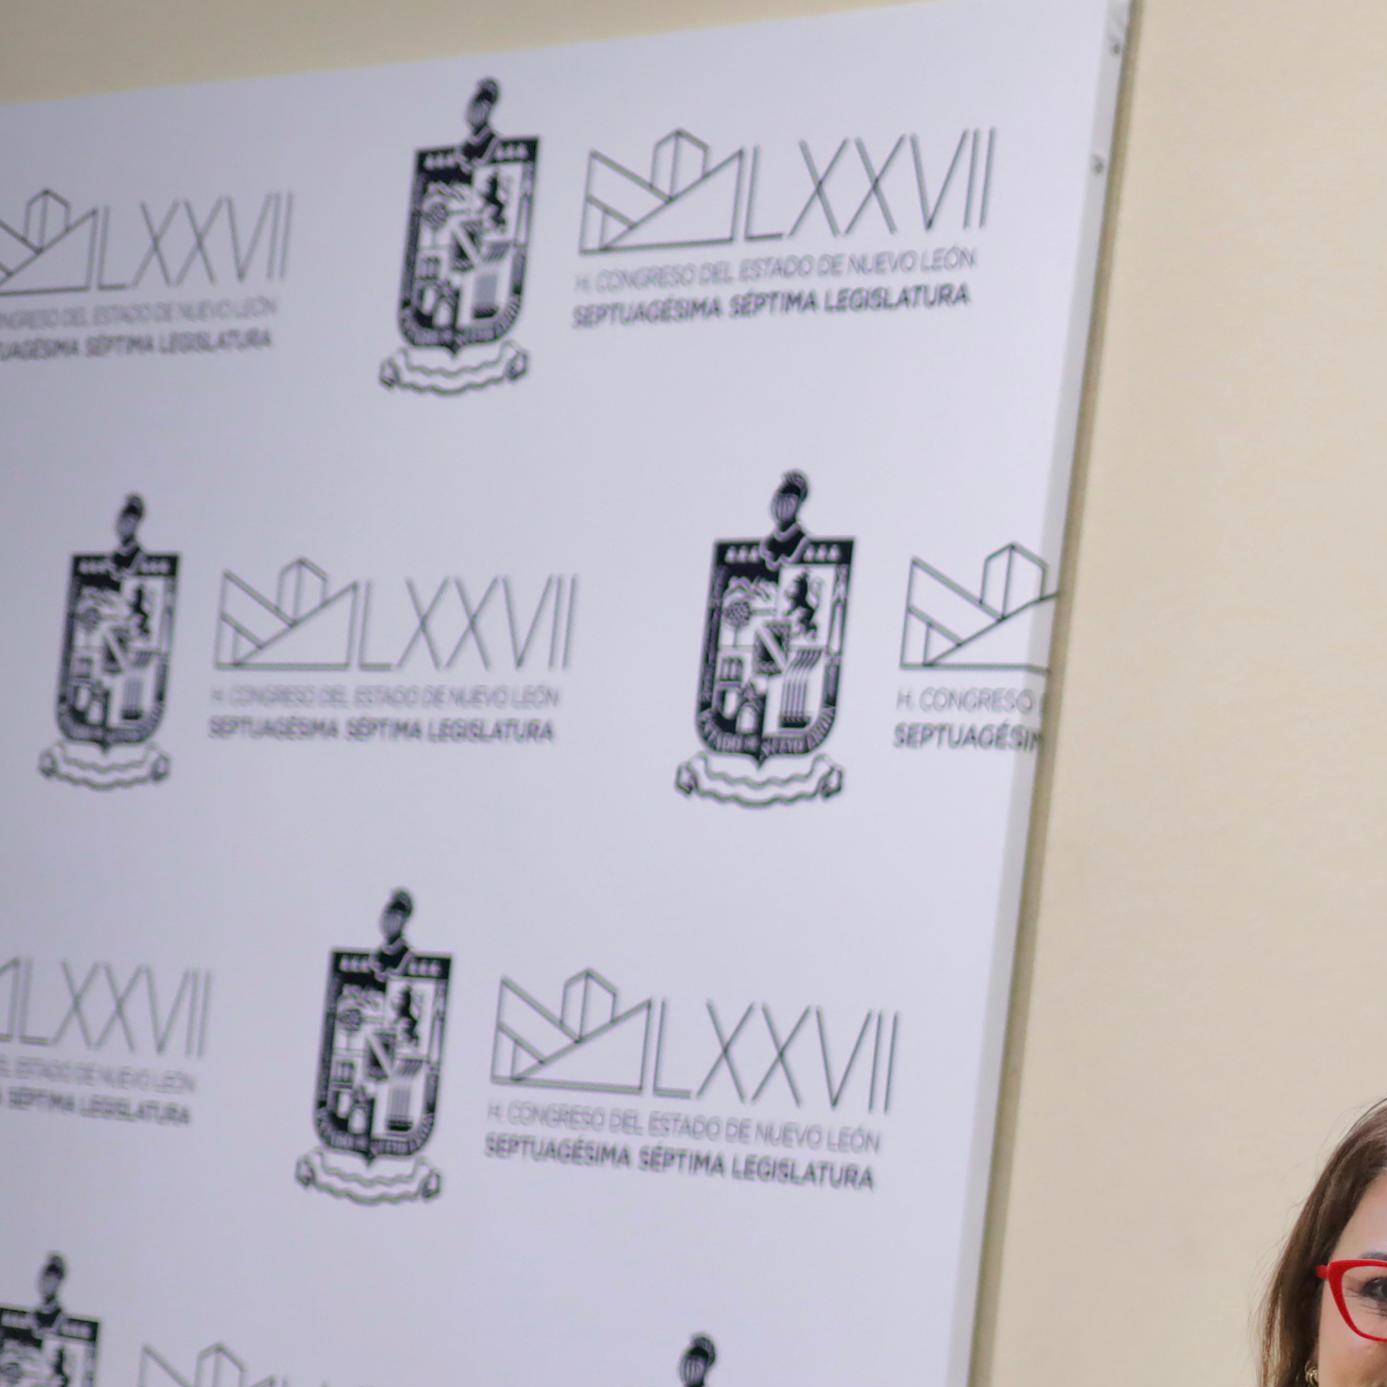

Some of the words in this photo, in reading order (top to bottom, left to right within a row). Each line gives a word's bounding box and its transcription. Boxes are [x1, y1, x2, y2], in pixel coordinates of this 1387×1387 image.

[744, 126, 998, 243] LXXVII
[97, 190, 294, 291] LXXVII
[824, 283, 971, 313] LEGISLATURA
[358, 572, 579, 672] LXXVII
[653, 996, 900, 1114] LXXVII
